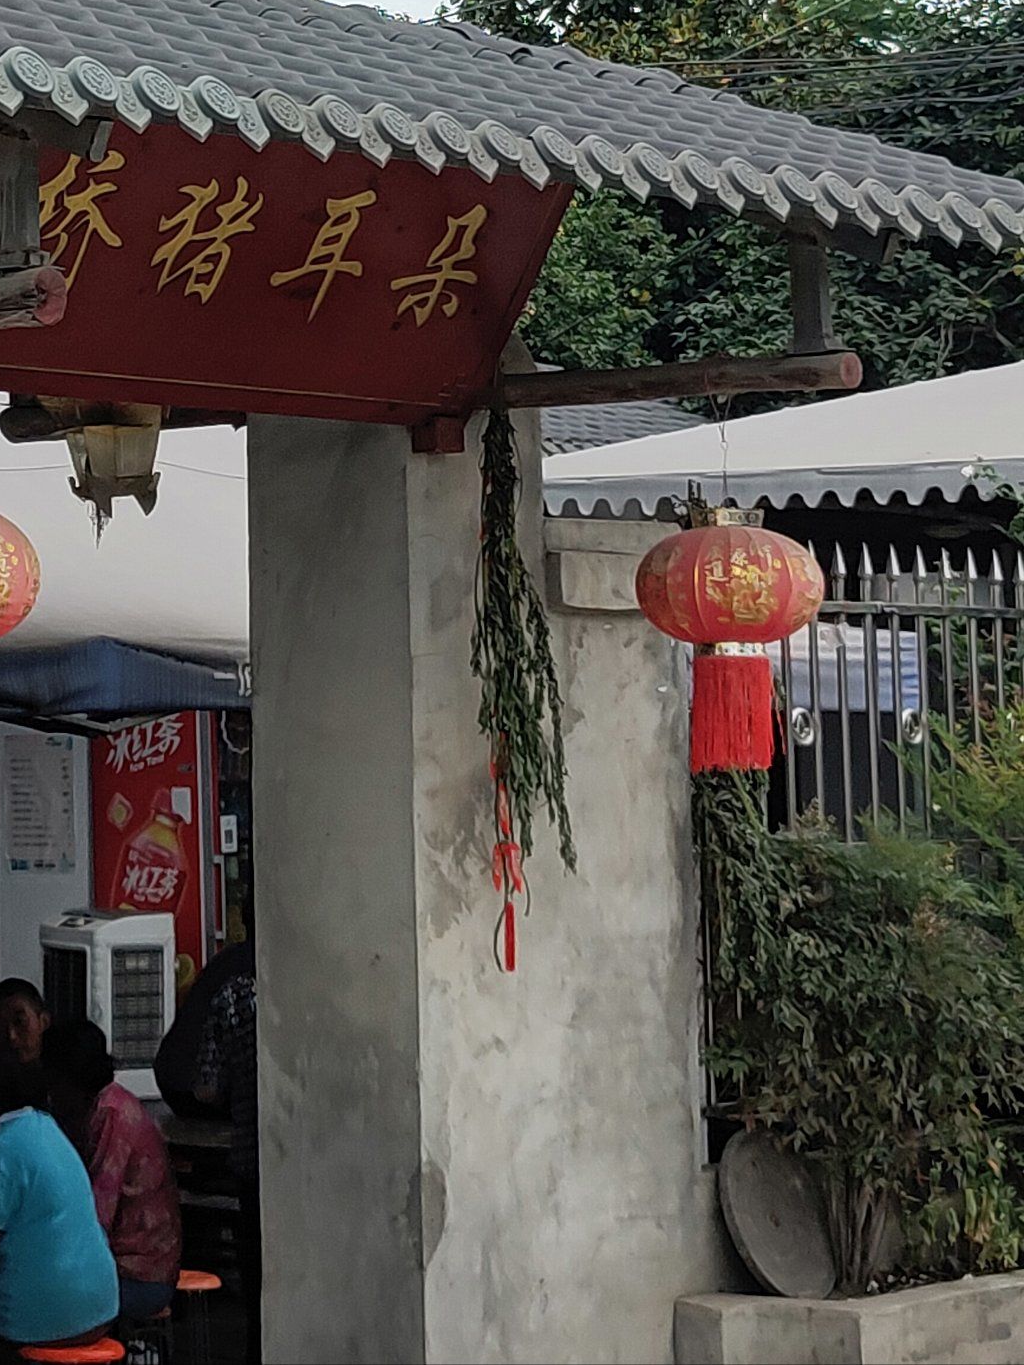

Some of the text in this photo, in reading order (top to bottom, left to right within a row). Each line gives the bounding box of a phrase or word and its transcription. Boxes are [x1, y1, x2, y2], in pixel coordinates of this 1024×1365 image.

[105, 713, 184, 774] 冰红茶
[121, 864, 179, 900] 冰红茶
